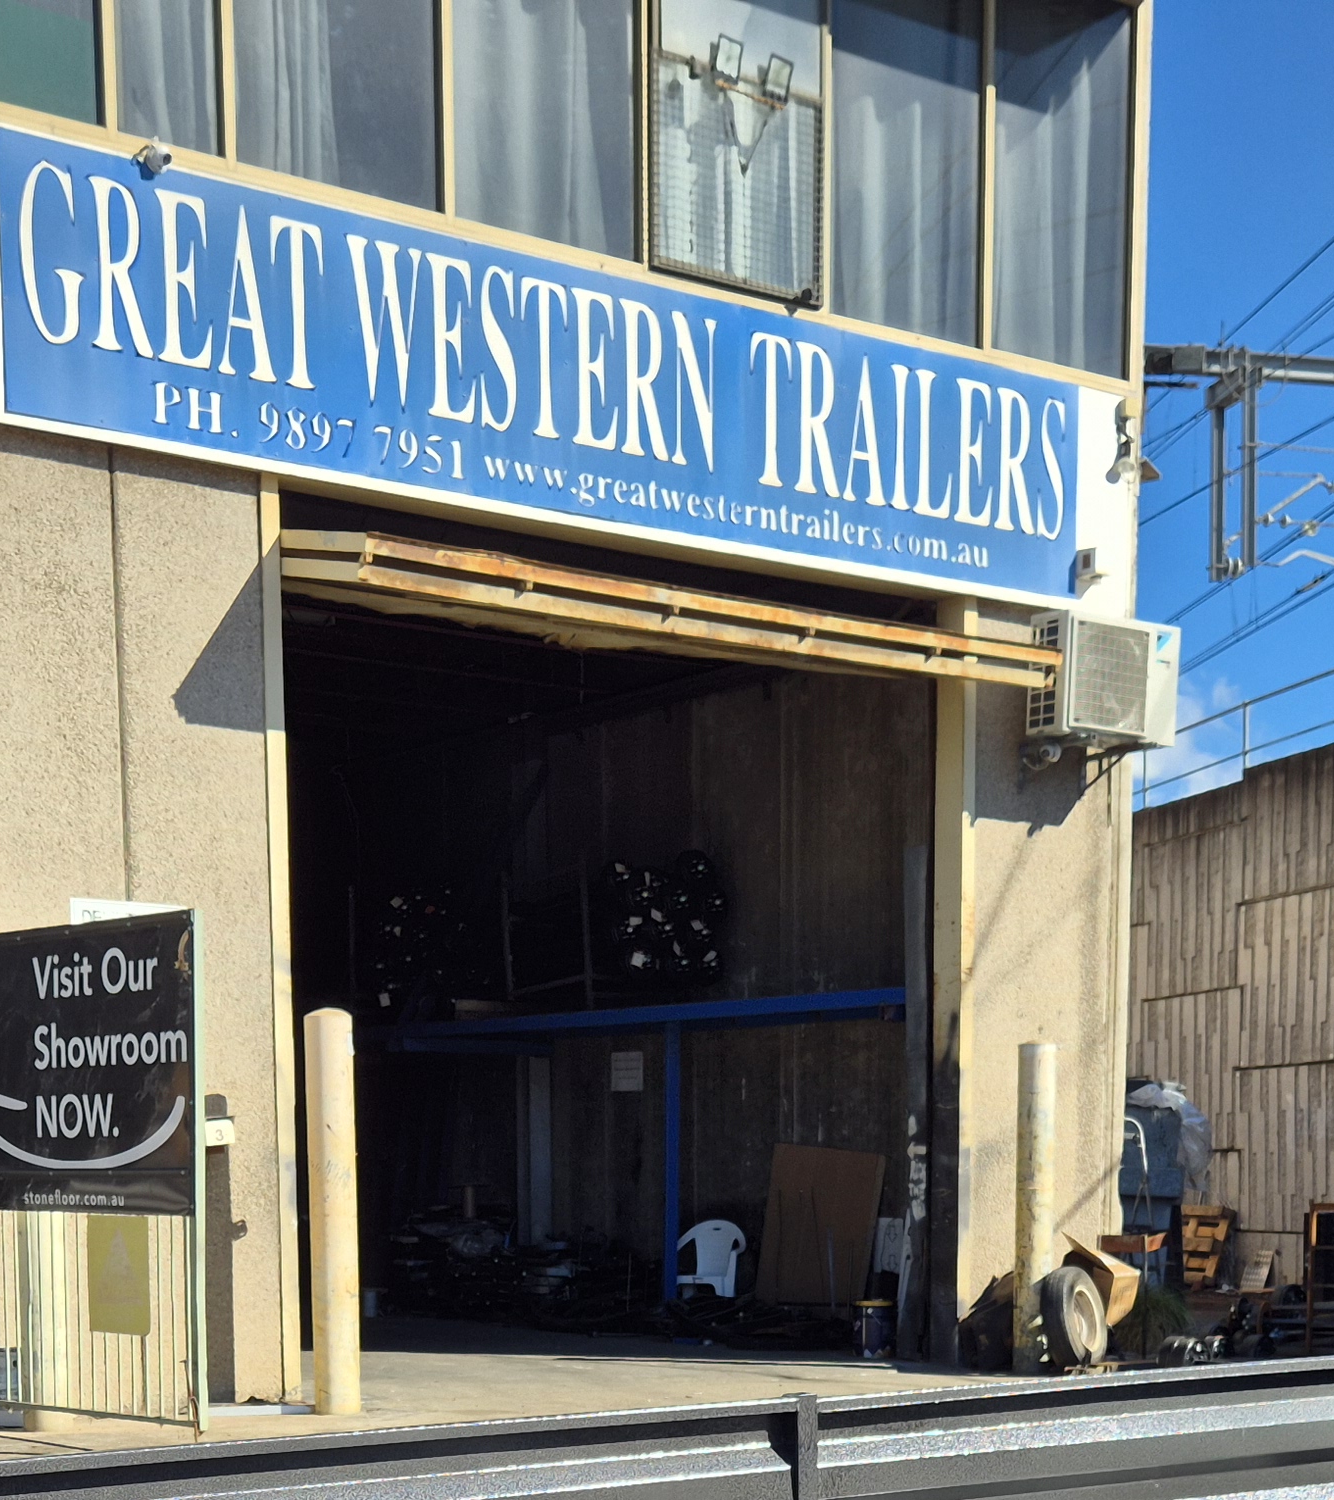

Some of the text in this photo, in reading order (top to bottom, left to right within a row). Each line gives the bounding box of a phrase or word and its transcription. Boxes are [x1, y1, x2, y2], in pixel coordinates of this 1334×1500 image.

[17, 159, 1065, 541] GREAT WESTERN TRAILERS
[153, 381, 989, 569] PH. 9897 7951 www.greatwesterntrailers.com.au
[32, 946, 158, 1000] Visit Our
[33, 1022, 188, 1071] Showroom
[36, 1092, 120, 1139] NOW.
[23, 1188, 125, 1207] stonefloor.com.au
